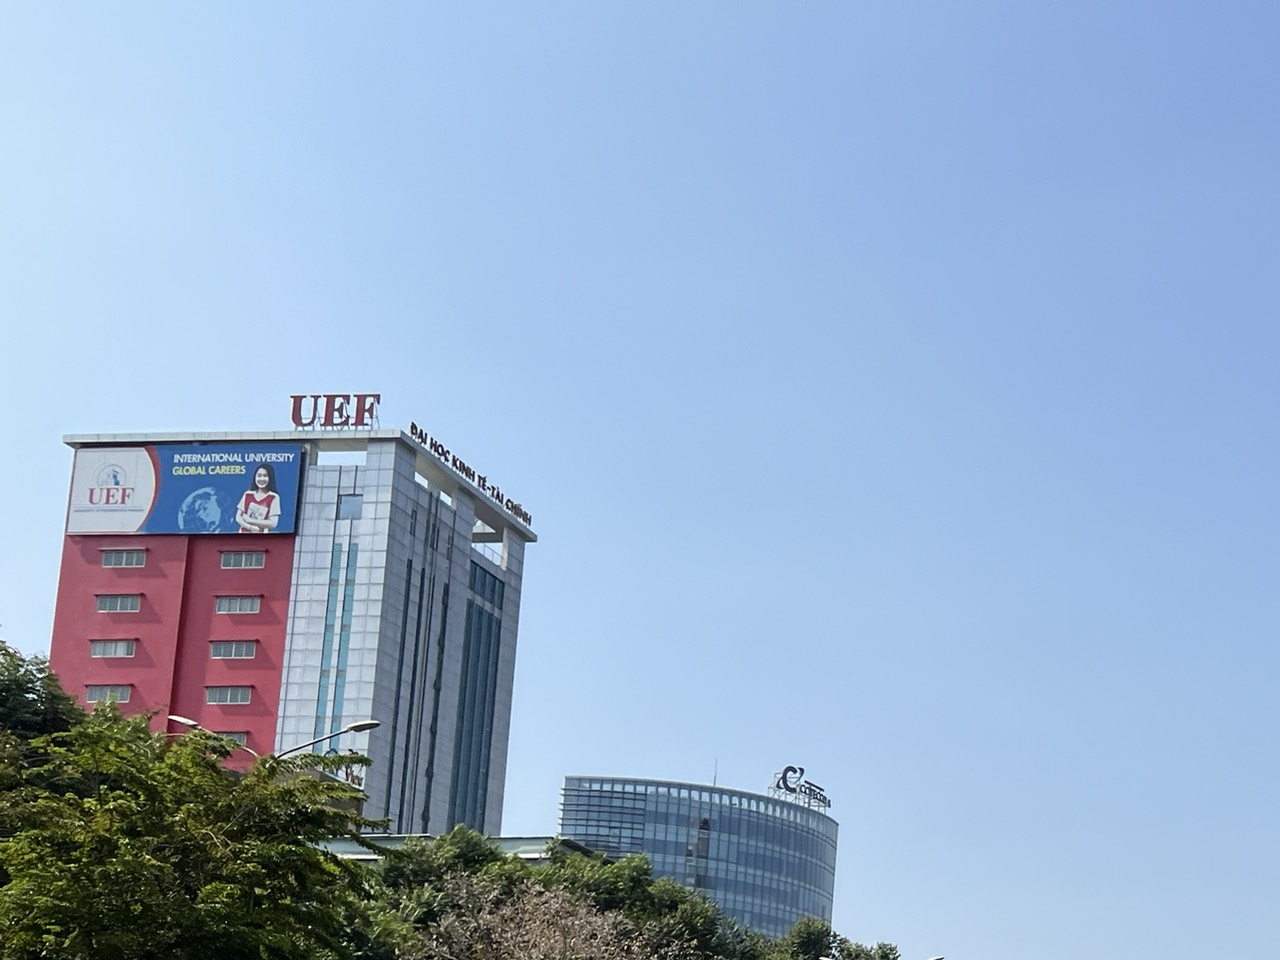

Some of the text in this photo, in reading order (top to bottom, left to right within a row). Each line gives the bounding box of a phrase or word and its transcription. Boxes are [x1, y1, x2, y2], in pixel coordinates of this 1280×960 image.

[290, 394, 381, 426] UEF
[173, 452, 295, 463] INTERNATIONAL UNIVERSITY
[172, 465, 246, 477] GLOBAL CAREERS
[410, 421, 428, 446] ĐẠI
[429, 436, 451, 462] HỌC
[452, 453, 475, 483] KINH
[505, 497, 532, 527] CHÍNH
[88, 487, 134, 505] UEF
